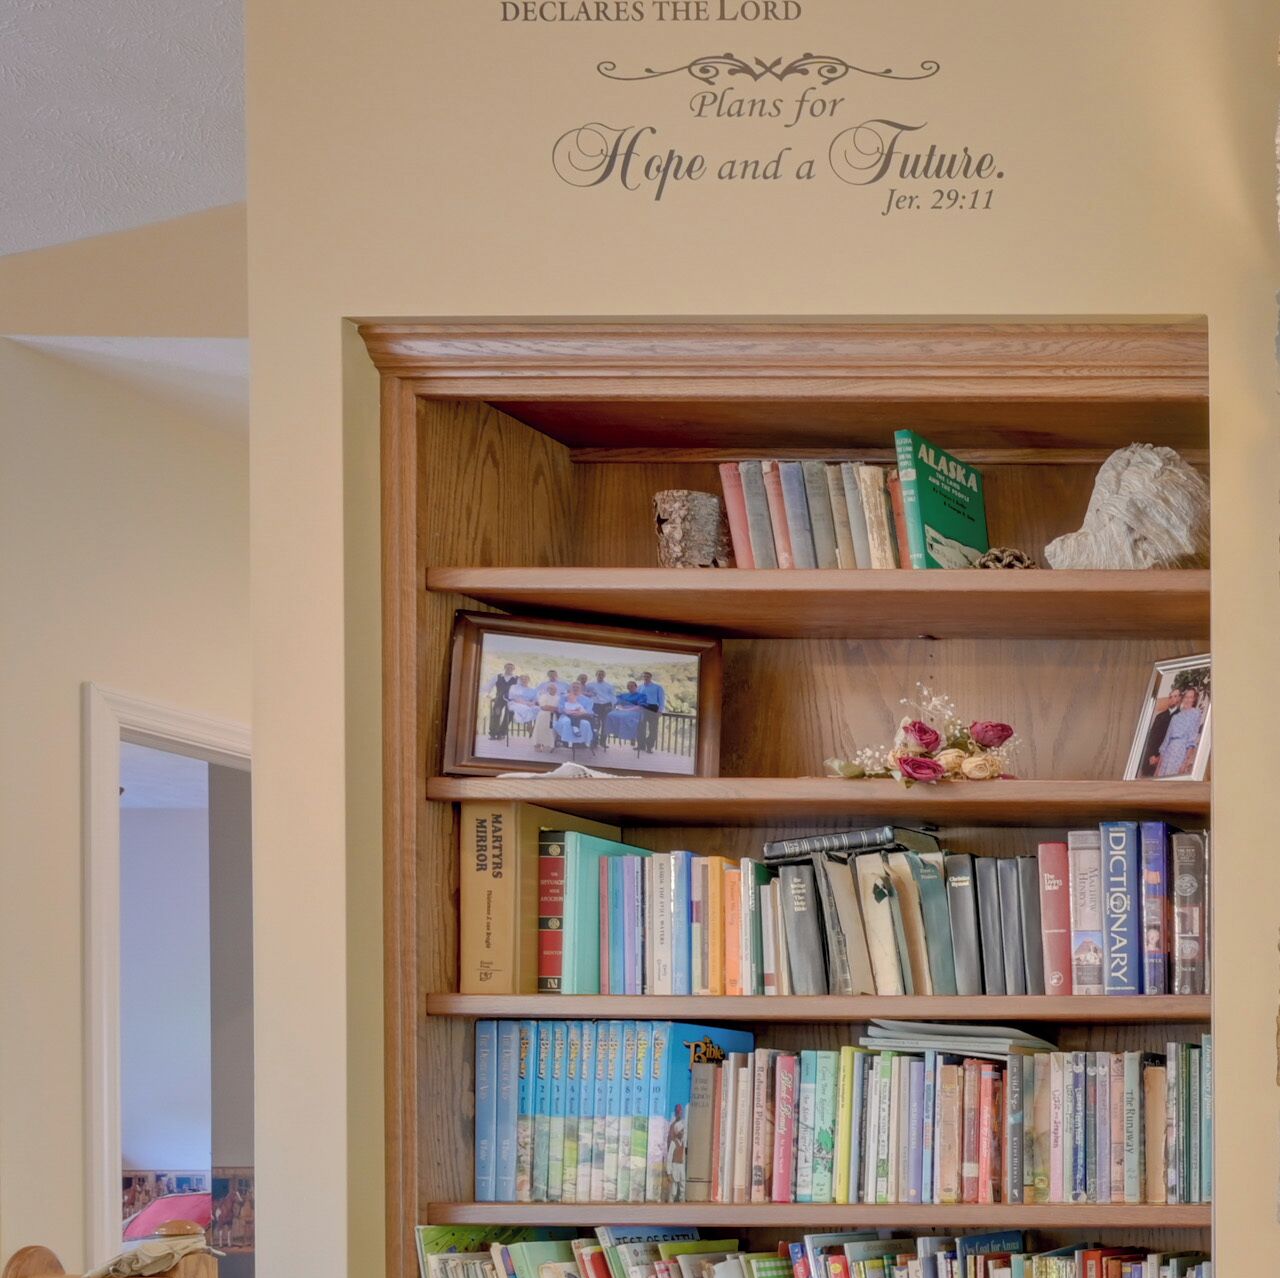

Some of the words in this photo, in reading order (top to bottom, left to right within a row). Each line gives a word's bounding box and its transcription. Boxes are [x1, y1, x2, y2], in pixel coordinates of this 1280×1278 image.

[500, 0, 645, 22] DECLARES
[656, 0, 710, 22] THE
[716, 0, 802, 21] LORD
[689, 87, 784, 118] Plans
[784, 87, 845, 127] for
[551, 121, 706, 201] Hope
[717, 147, 793, 181] and
[796, 158, 816, 180] a
[828, 118, 1005, 186] Future.
[881, 188, 921, 216] Jer.
[930, 187, 995, 210] 29:11
[918, 443, 978, 493] ALASKA
[475, 818, 488, 872] MIRROR
[491, 813, 503, 879] MARTYRS
[1108, 832, 1128, 983] DICTIONARY
[1126, 1109, 1136, 1154] Runaway
